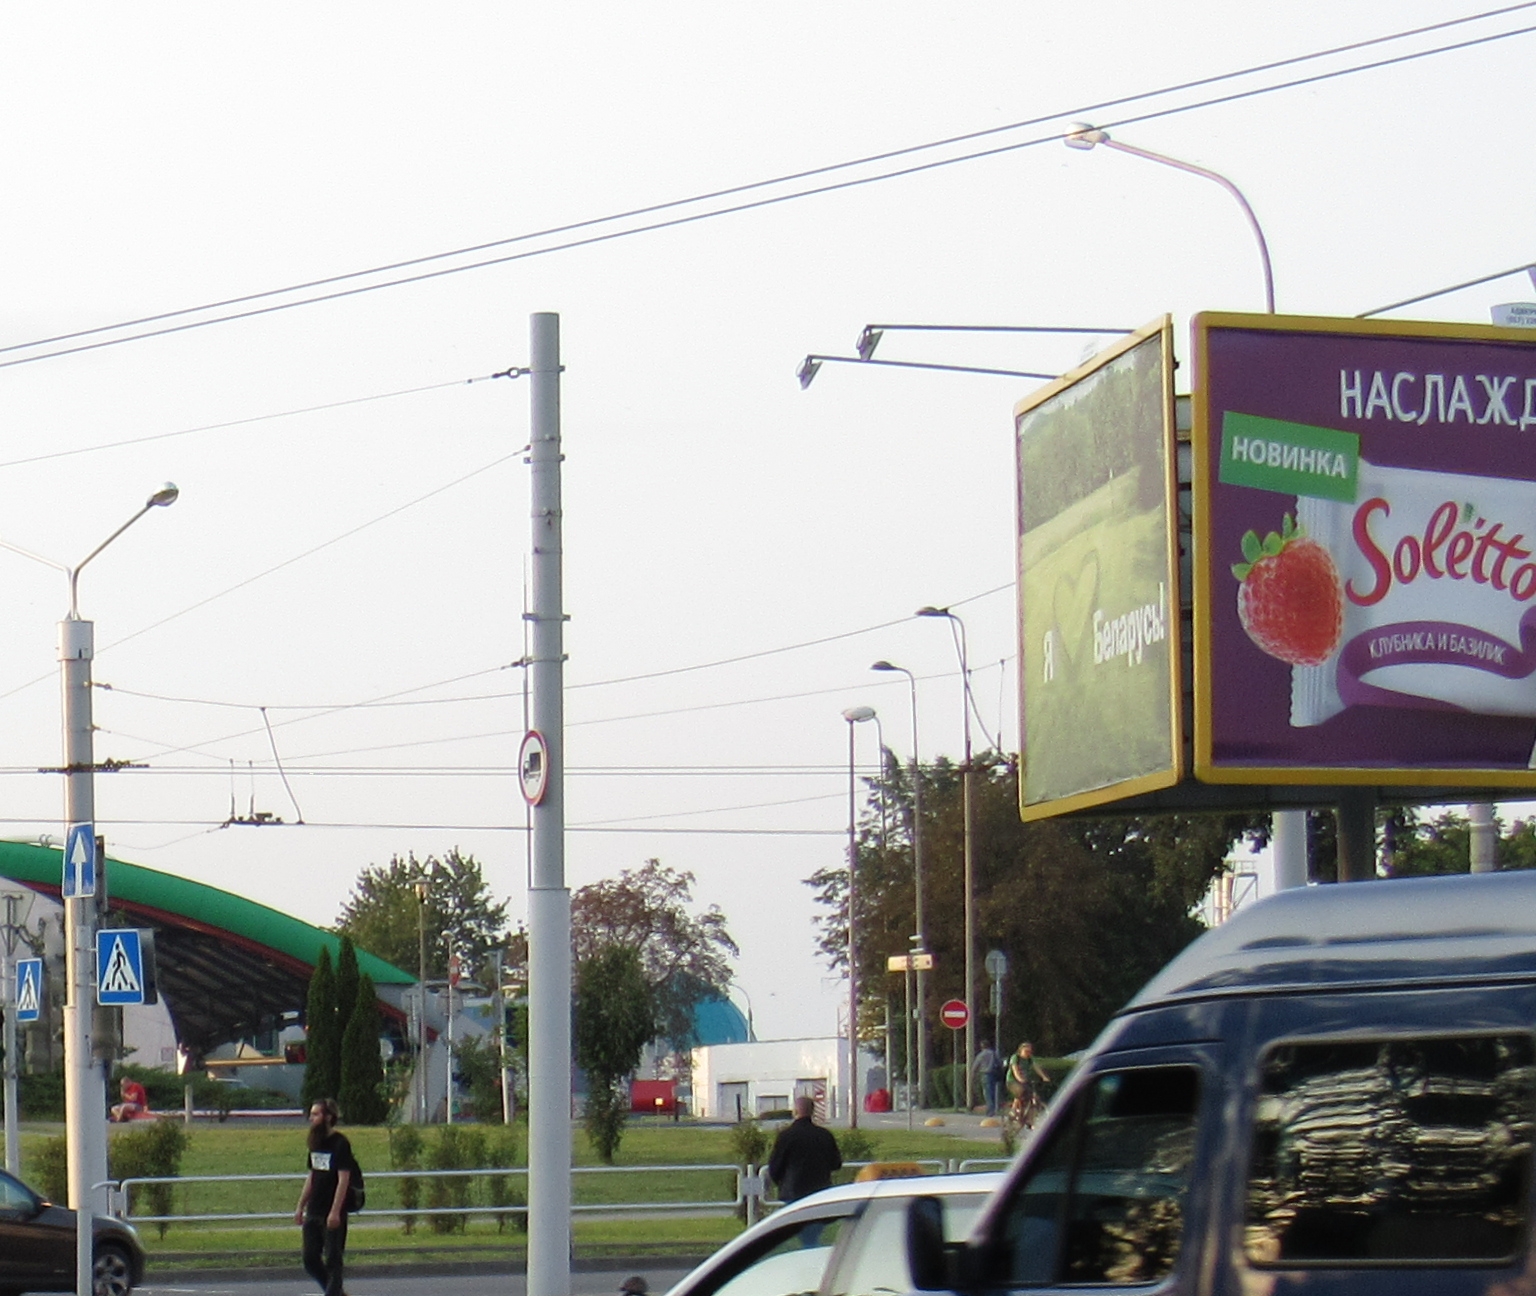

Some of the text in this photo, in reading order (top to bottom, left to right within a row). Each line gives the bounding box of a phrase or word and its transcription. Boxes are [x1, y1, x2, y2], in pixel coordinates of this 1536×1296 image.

[1232, 435, 1346, 479] НОВИНКА
[1044, 582, 1165, 683] Я Беларусь!
[1369, 632, 1507, 665] КЛУБНИКА И БАЗИЛИК
